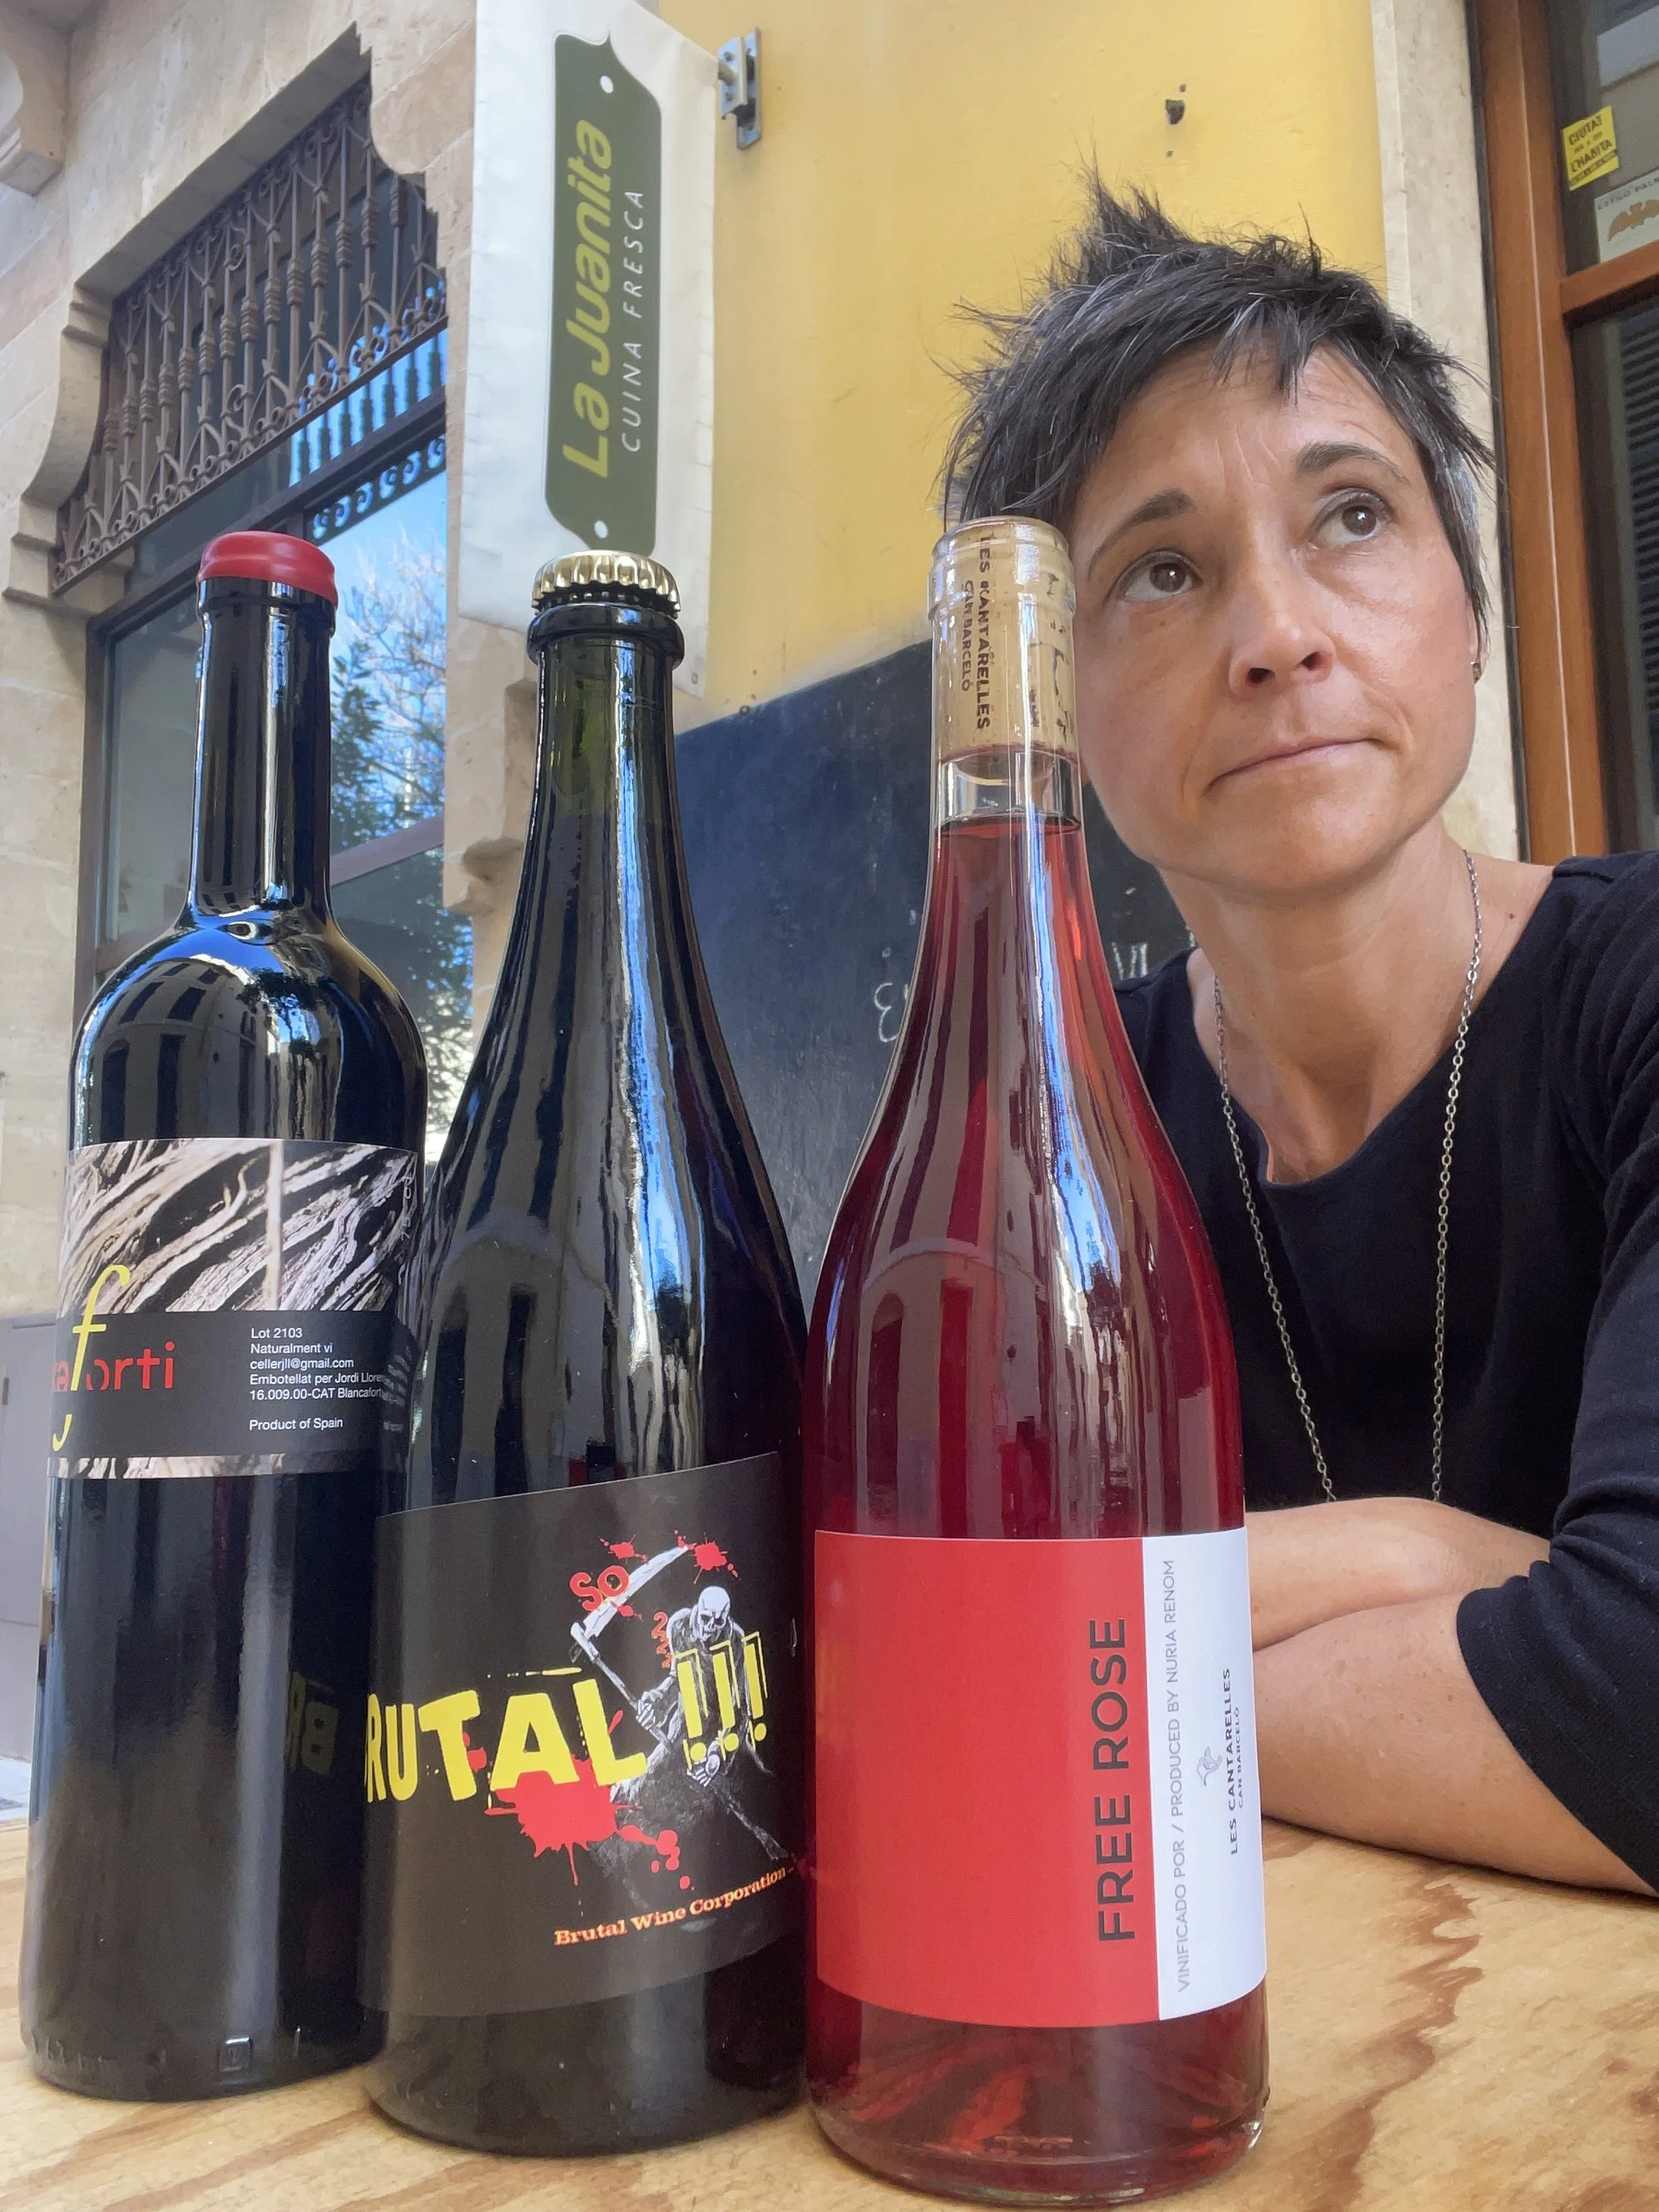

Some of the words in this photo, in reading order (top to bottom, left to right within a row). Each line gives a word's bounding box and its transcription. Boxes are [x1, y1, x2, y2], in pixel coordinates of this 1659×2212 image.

[566, 120, 612, 376] Juanita
[623, 191, 644, 318] FRESCA
[622, 342, 643, 452] CUINA
[562, 382, 610, 479] La
[250, 1357, 354, 1372] cellerjll@gmail.com
[251, 1327, 271, 1339] Lot
[273, 1327, 303, 1339] 2103
[251, 1342, 321, 1355] Naturalment
[323, 1342, 333, 1354] vi
[250, 1373, 312, 1385] Embotellat
[314, 1375, 332, 1387] per
[335, 1372, 359, 1384] Jordi
[361, 1372, 382, 1382] Llore
[250, 1388, 335, 1400] 16.009.00-CAT
[249, 1418, 296, 1431] Product
[299, 1418, 311, 1429] of
[313, 1417, 343, 1430] Spain
[569, 1565, 630, 1612] SO
[1163, 1559, 1176, 1624] RENOM
[1165, 1629, 1178, 1683] NURIA
[1090, 1619, 1129, 1771] ROSE
[1167, 1690, 1180, 1713] BY
[364, 1678, 648, 1803] RUTAL
[1168, 1718, 1183, 1817] PRODUCED
[1223, 1667, 1236, 1812] CANTARELLES
[1094, 1795, 1135, 1942] FREE
[1173, 1840, 1186, 1878] POR
[1229, 1817, 1238, 1855] LES
[554, 1919, 627, 1946] Brutal
[630, 1907, 686, 1930] Wine
[689, 1866, 786, 1915] Corporation
[1175, 1883, 1191, 1994] VINIFICADO
